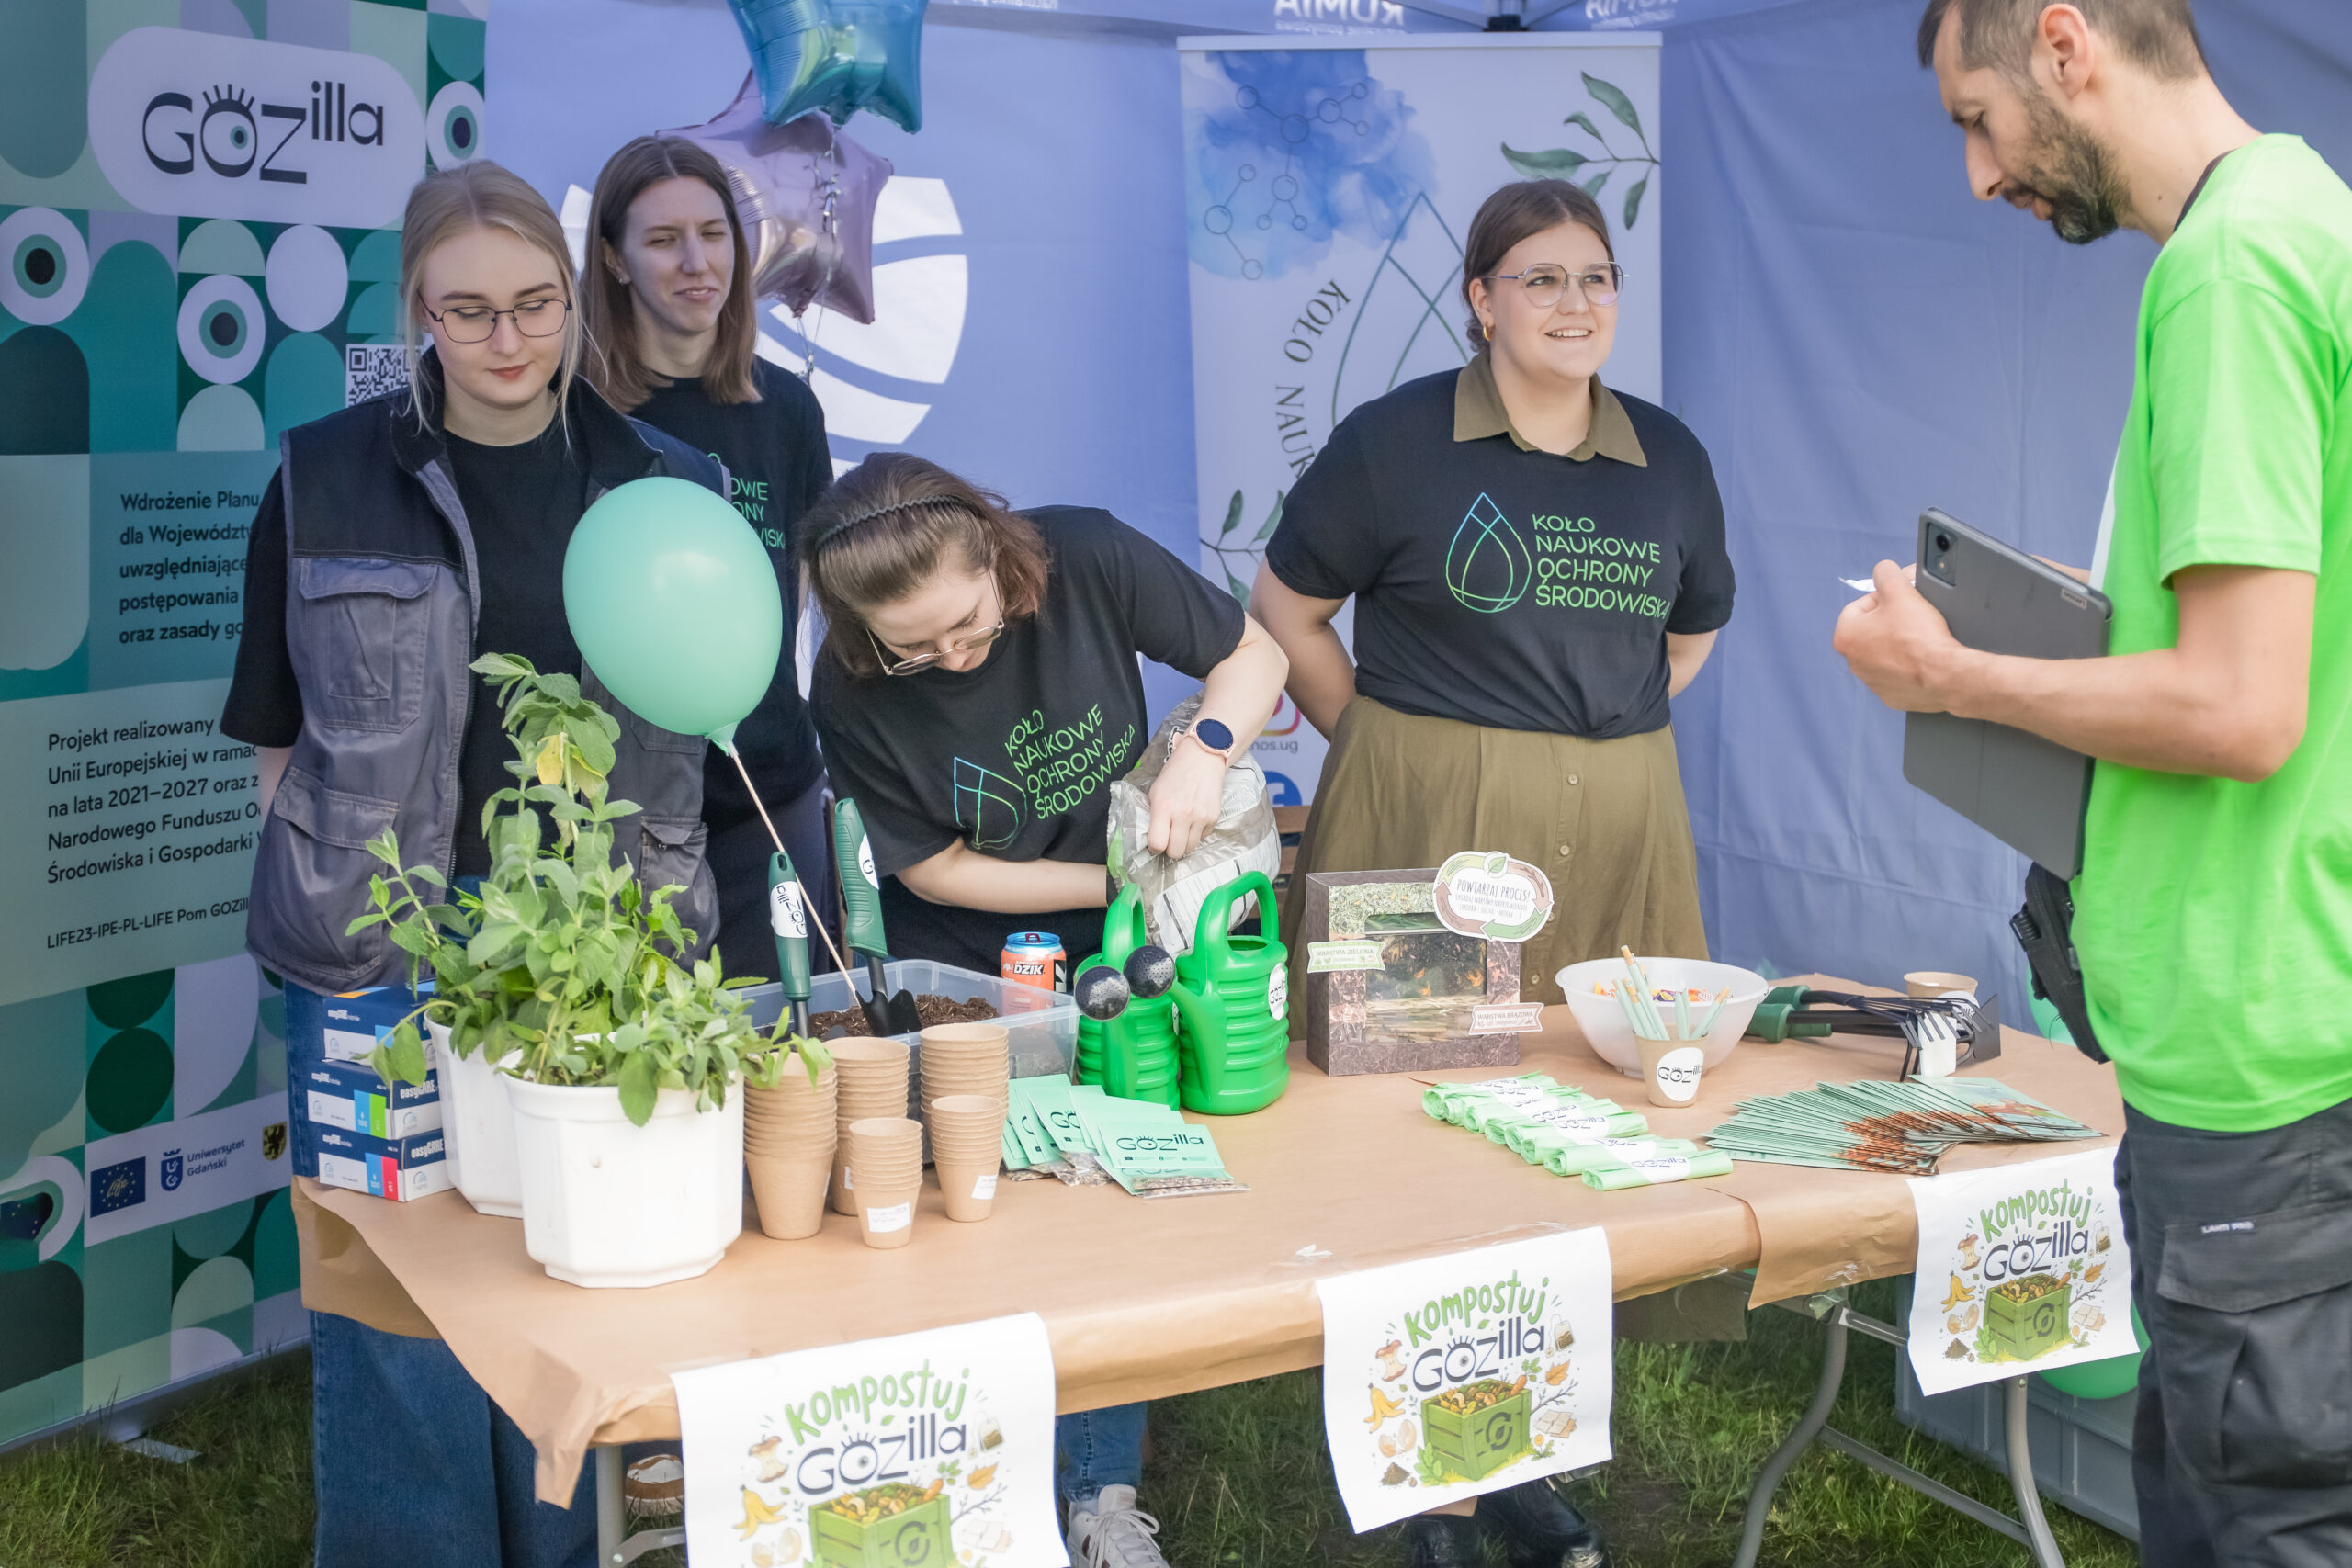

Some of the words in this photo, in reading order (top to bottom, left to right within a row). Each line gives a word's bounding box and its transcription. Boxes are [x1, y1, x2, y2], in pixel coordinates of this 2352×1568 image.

[1283, 278, 1351, 363] KOŁO
[1275, 385, 1317, 479] NAUK
[120, 491, 212, 512] Wdrożenie
[217, 491, 260, 508] Planu
[119, 526, 144, 545] dla
[1532, 513, 1596, 533] KOŁO
[1535, 534, 1661, 564] NAUKOWE
[1537, 558, 1654, 588] OCHRONY
[119, 586, 239, 615] postępowania
[1535, 578, 1671, 620] ŚRODOWISKA
[119, 628, 155, 645] oraz
[159, 620, 220, 641] zasady
[48, 727, 108, 753] Projekt
[113, 719, 215, 743] realizowany
[1005, 709, 1044, 759] KOŁO
[1013, 703, 1103, 777] NAUKOWE
[1249, 740, 1299, 754] nos.ug
[48, 762, 81, 785] Unii
[85, 749, 187, 777] Europejskiej
[192, 750, 208, 765] w
[212, 744, 258, 763] ramac
[1026, 729, 1104, 794] OCHRONY
[1035, 723, 1136, 820] ŚRODOWISKA
[48, 801, 69, 818] na
[74, 795, 104, 815] lata
[107, 777, 209, 808] 2021–2027
[213, 775, 248, 794] oraz
[251, 774, 260, 788] z
[48, 818, 157, 852] Narodowego
[162, 808, 242, 831] Funduszu
[47, 851, 144, 884] Środowiska
[148, 847, 153, 865] i
[158, 830, 254, 863] Gospodarki
[1457, 878, 1499, 897] POWTARZAJ
[1500, 886, 1531, 903] PROCES!
[47, 909, 174, 950] LIFE23-IPE-PL-LIFE
[177, 908, 208, 924] Pom
[210, 897, 250, 918] GOZill
[1013, 964, 1045, 976] DZIK
[187, 1139, 246, 1163] Uniwersytet
[411, 1139, 444, 1158] easyCARE
[187, 1158, 228, 1177] Gdański
